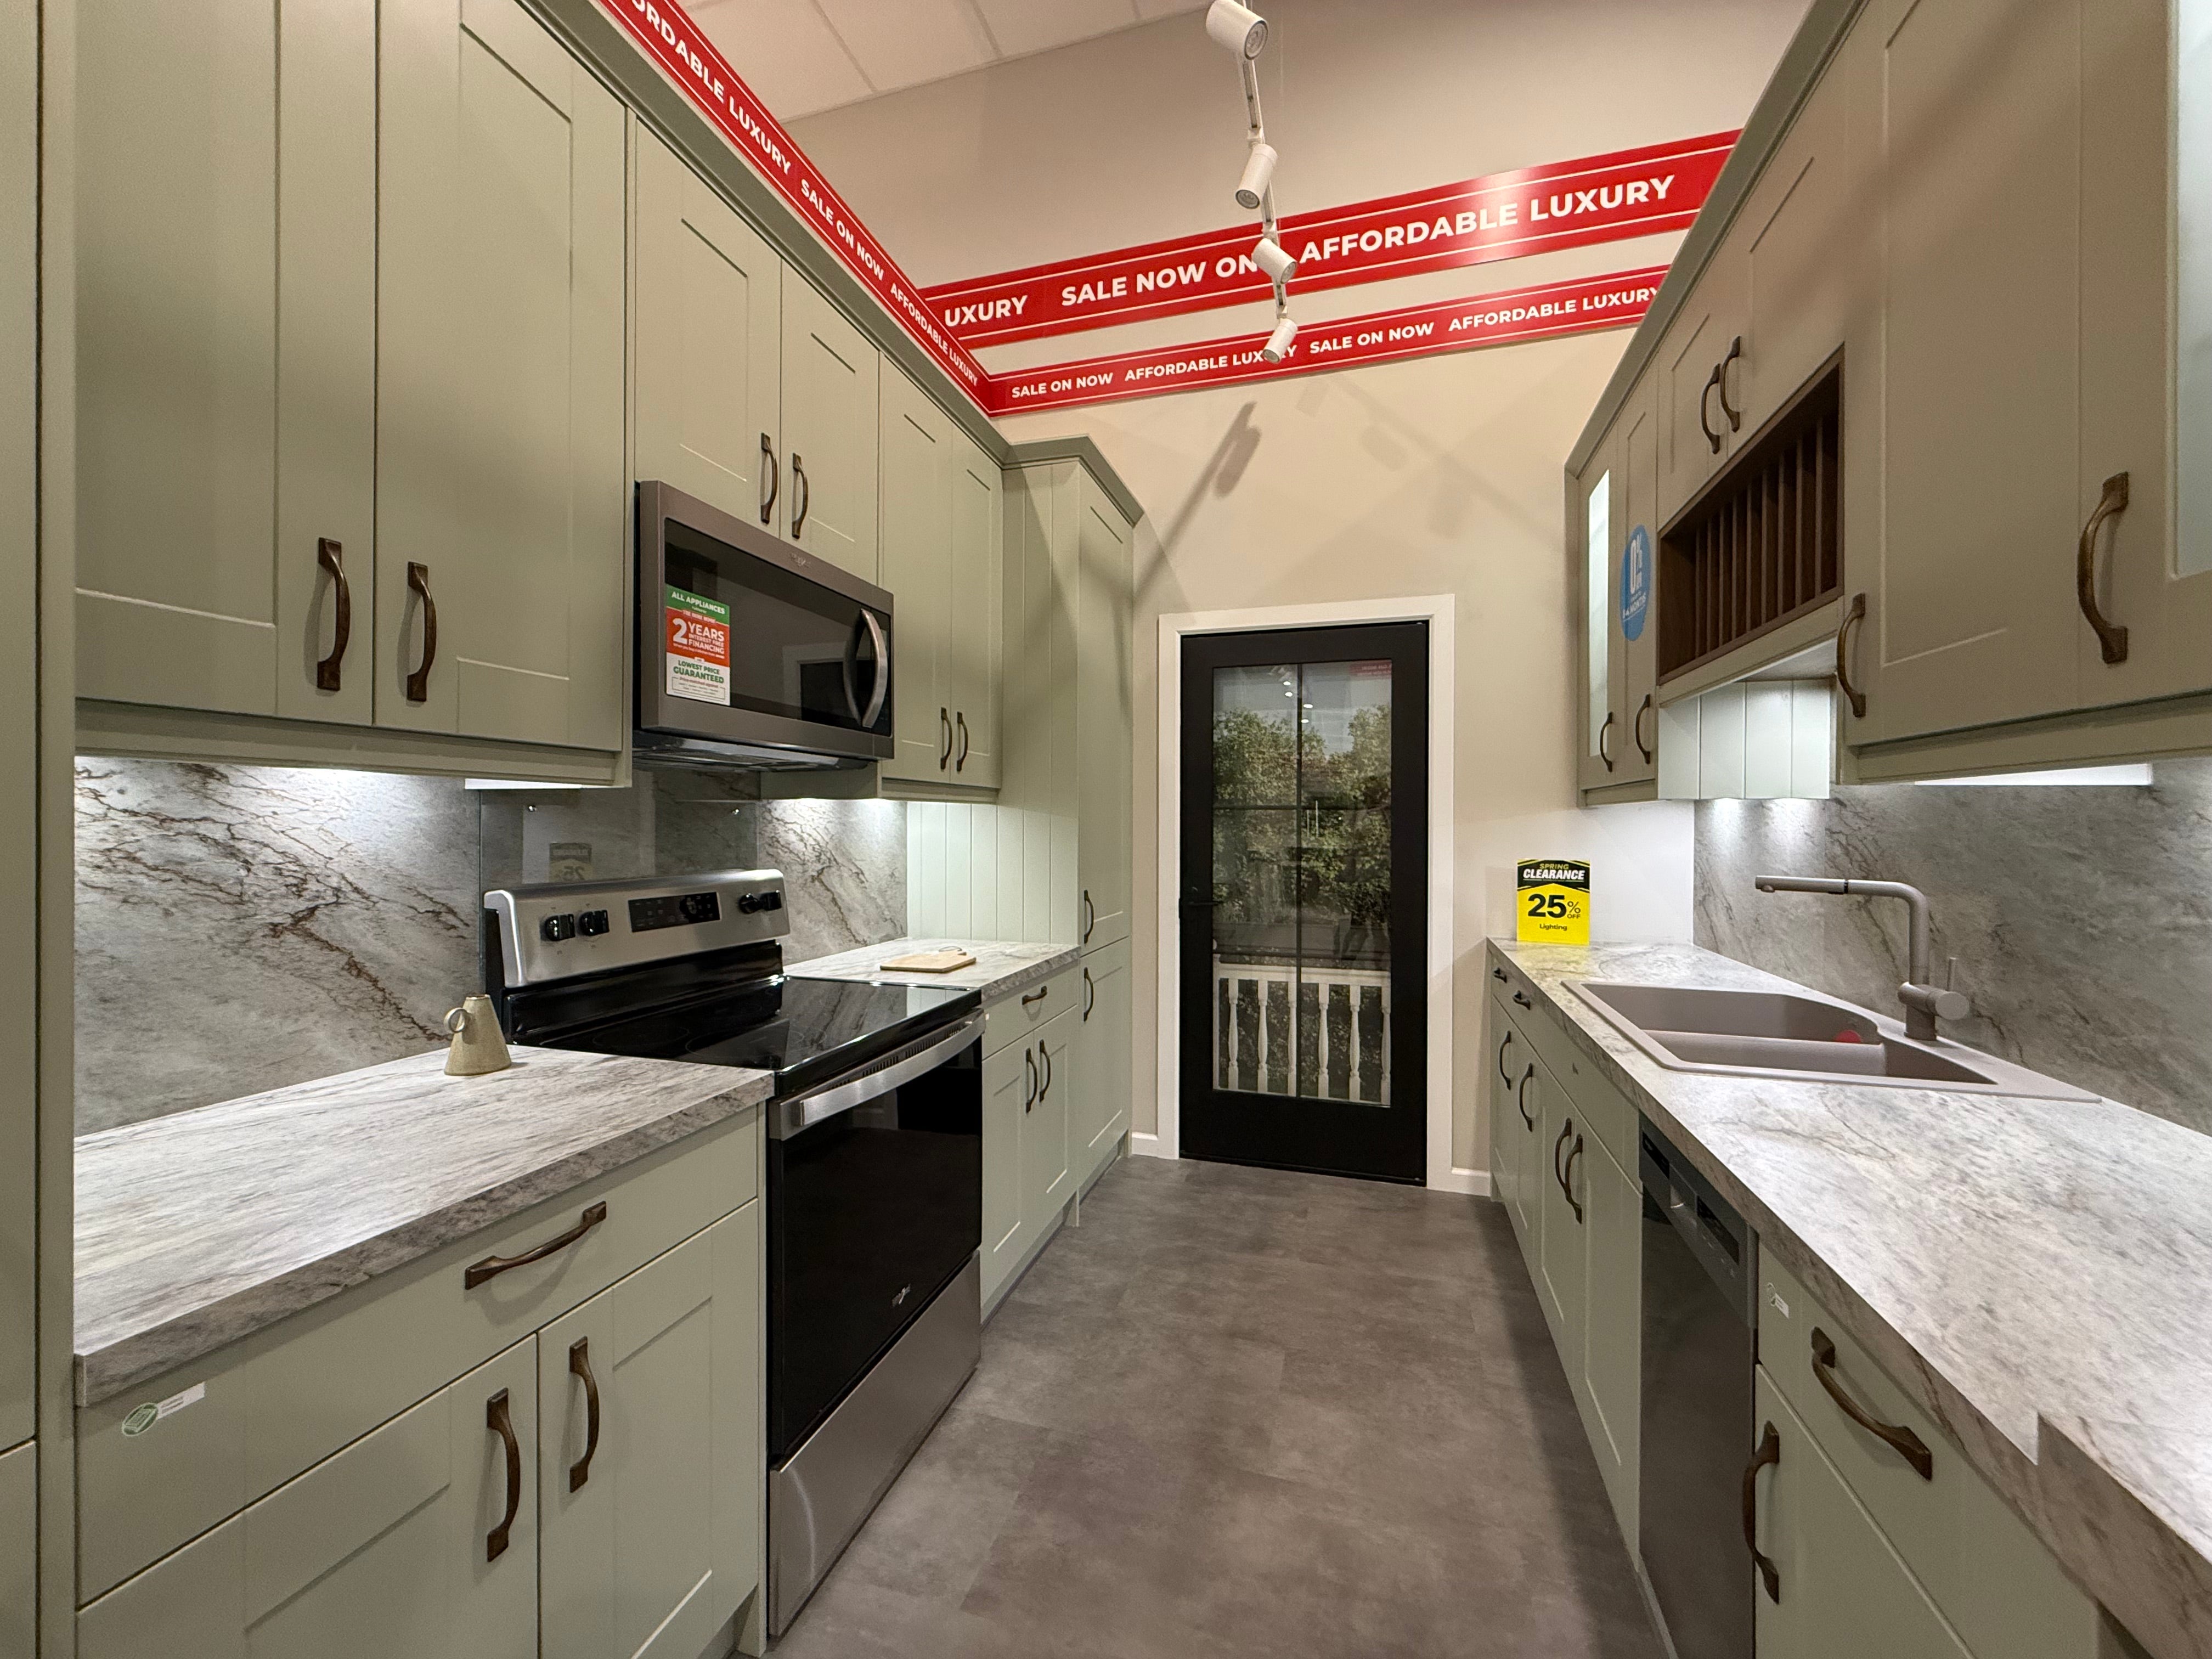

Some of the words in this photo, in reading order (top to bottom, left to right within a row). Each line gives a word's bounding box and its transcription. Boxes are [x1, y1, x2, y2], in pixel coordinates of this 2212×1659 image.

[729, 96, 791, 175] LUXURY
[801, 179, 834, 225] SALE
[836, 220, 854, 249] ON
[857, 241, 884, 281] NOW
[890, 283, 948, 354] AFFORDABLE
[949, 348, 978, 386] LUXURY
[945, 295, 1028, 327] UXURY
[1062, 276, 1127, 306] SALE
[1137, 261, 1206, 293] NOW
[1215, 254, 1257, 278] ON
[1299, 203, 1519, 264] AFFORDABLE
[1530, 174, 1675, 222] LUXURY
[1012, 382, 1047, 398] SALE
[1051, 379, 1072, 393] ON
[1076, 372, 1114, 388] NOW
[1124, 356, 1228, 382] AFFORDABLE
[1233, 345, 1297, 366] LUXY
[1310, 336, 1352, 354] SALE
[1357, 330, 1383, 346] ON
[1389, 321, 1435, 341] NOW
[1448, 299, 1577, 332] AFFORDABLE
[672, 591, 685, 601] ALL
[686, 596, 725, 614] APPLIANCES
[673, 618, 687, 645] 2
[688, 621, 724, 642] YEARS
[689, 633, 712, 644] INTEREST
[689, 639, 724, 654] FINANCING
[673, 666, 725, 684] GUARANTEED
[678, 660, 702, 670] LOWEST
[703, 666, 720, 675] PRICE
[1523, 868, 1585, 880] CLEARANCE
